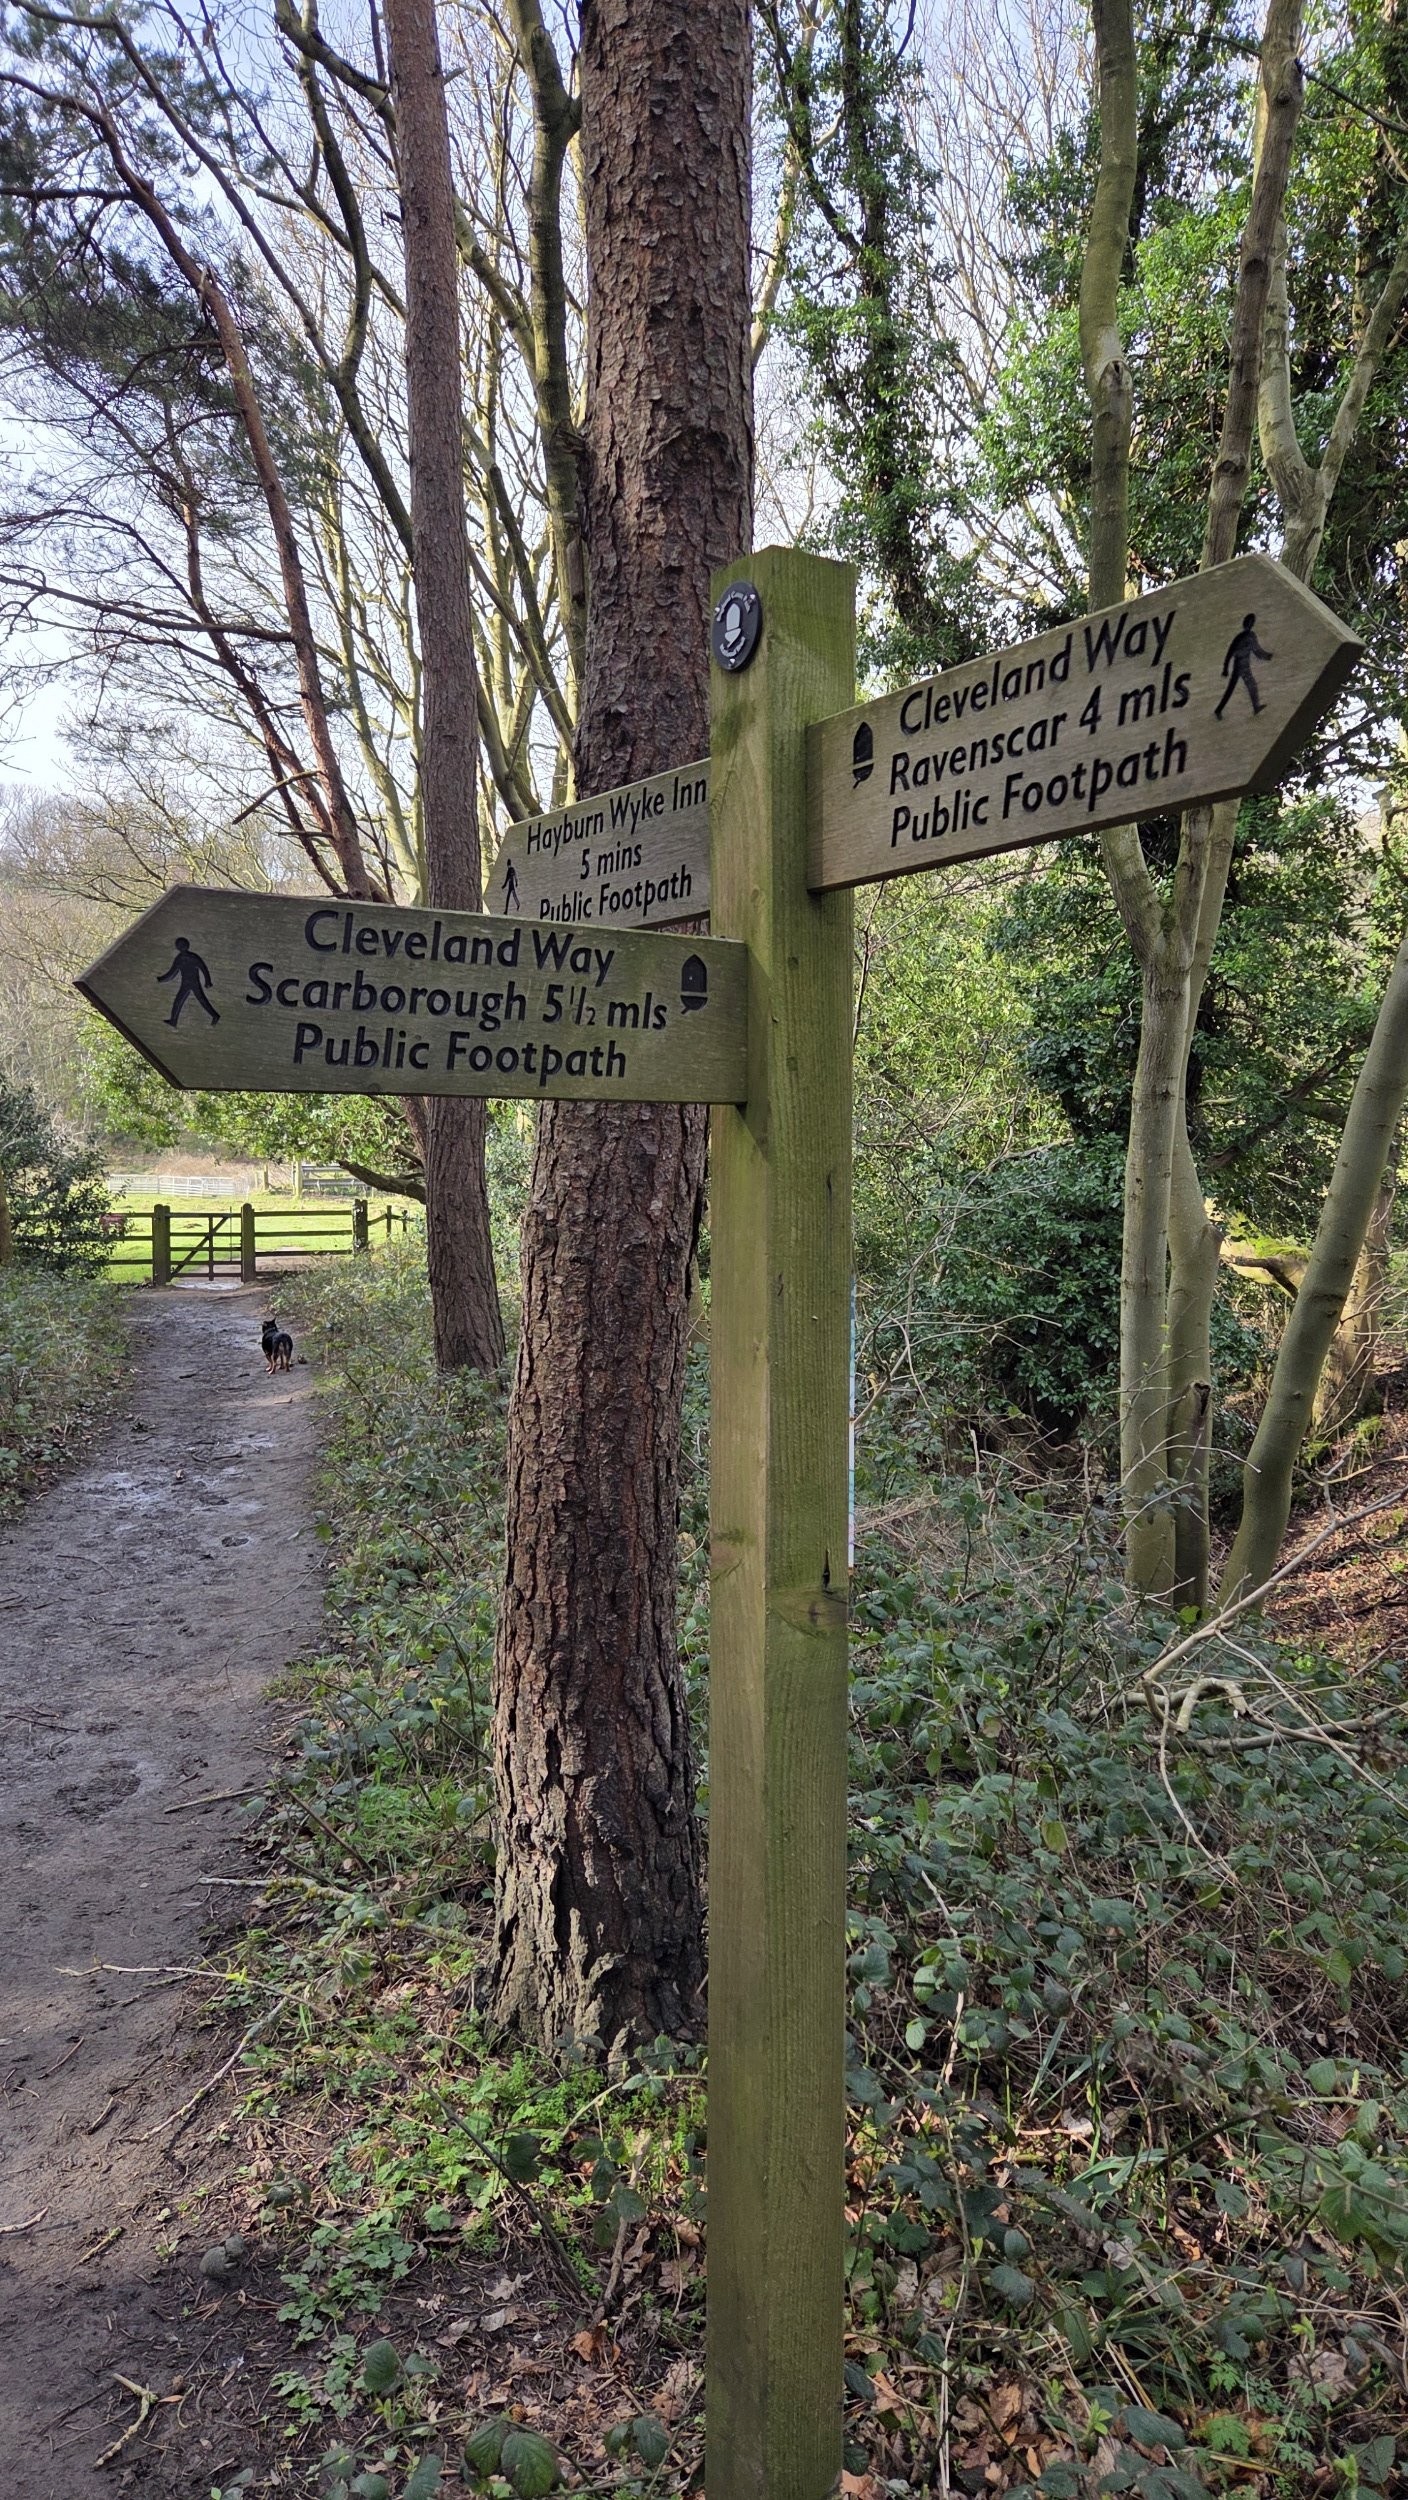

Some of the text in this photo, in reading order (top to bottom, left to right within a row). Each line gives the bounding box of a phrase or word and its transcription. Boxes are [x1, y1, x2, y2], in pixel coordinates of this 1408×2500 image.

[900, 610, 1177, 735] Cleveland Way
[890, 661, 1191, 795] Ravenscar 4 mls
[527, 776, 707, 857] Hayburn Wyke Inn
[891, 727, 1188, 847] Public Footpath
[539, 864, 692, 922] Public Footpath
[580, 841, 642, 880] 5 mins
[304, 909, 615, 988] Cleveland Way
[246, 962, 527, 1031] Scarborough
[607, 992, 668, 1030] mls
[293, 1022, 626, 1087] Public Footpath
